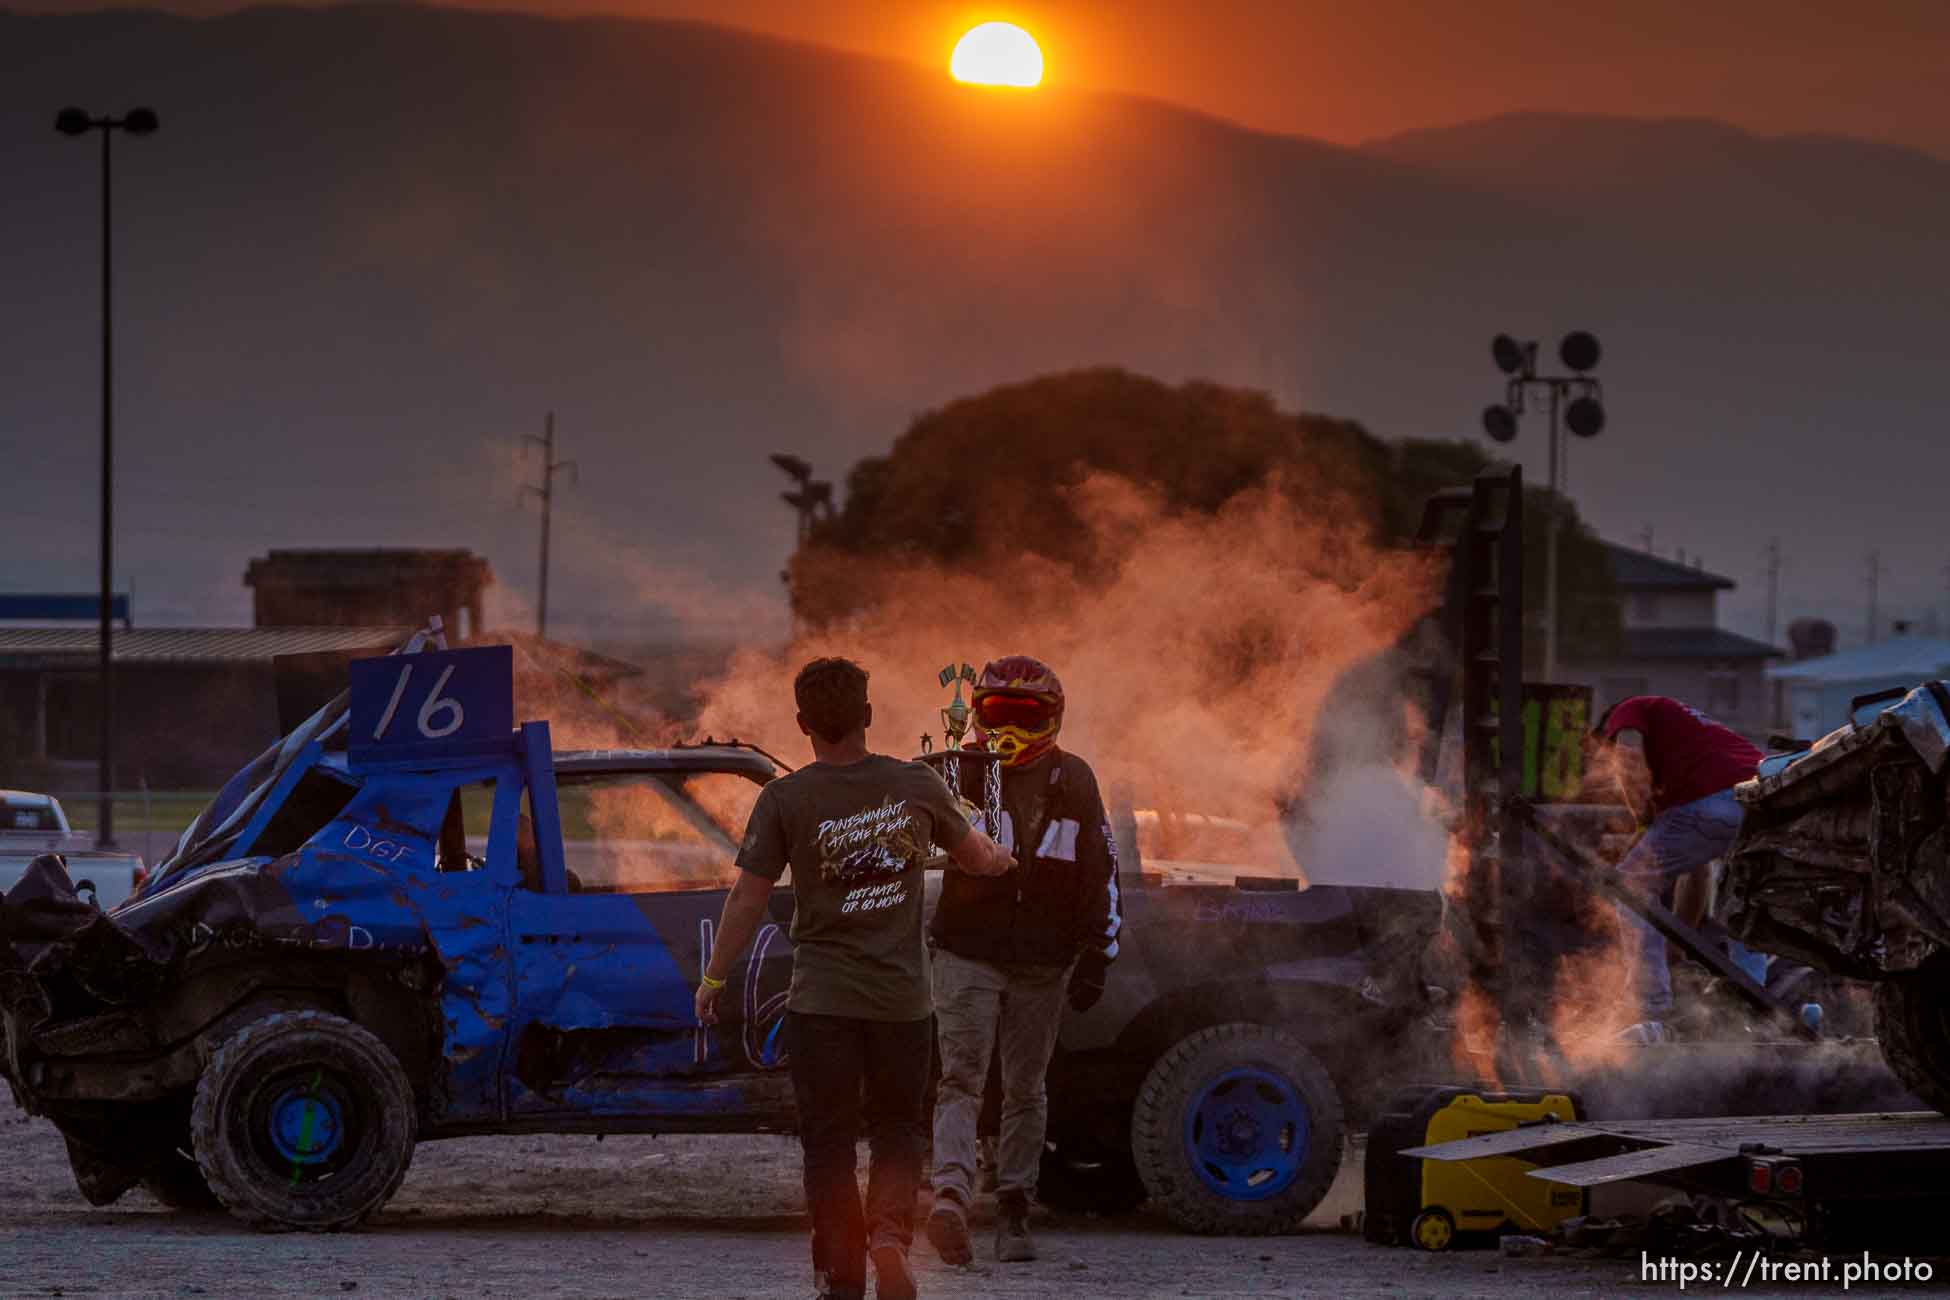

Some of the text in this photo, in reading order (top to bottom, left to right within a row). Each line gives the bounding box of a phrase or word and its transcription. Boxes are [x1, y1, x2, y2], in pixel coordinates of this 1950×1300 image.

[372, 664, 465, 740] 16
[817, 799, 907, 840] PUNISHMENT
[828, 815, 912, 848] AT THE PEAK
[841, 901, 860, 913] OR
[876, 892, 907, 909] HOME
[869, 880, 903, 897] HARD
